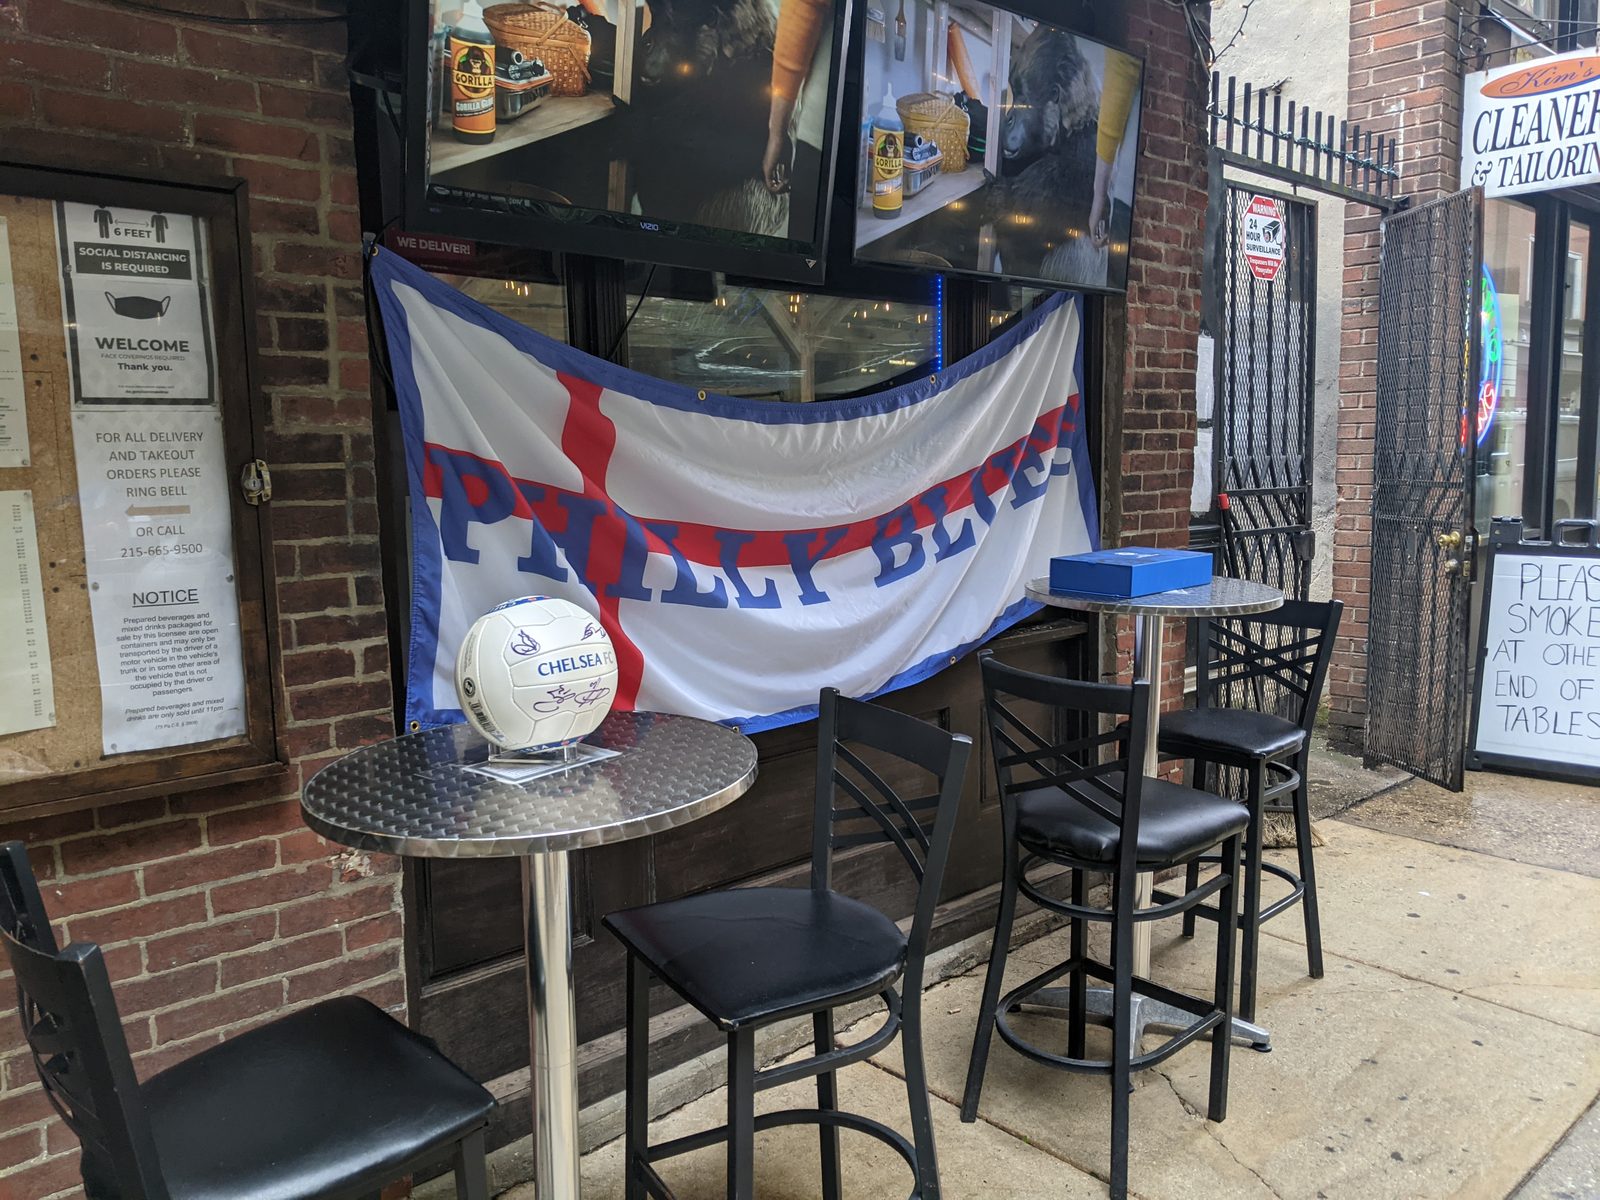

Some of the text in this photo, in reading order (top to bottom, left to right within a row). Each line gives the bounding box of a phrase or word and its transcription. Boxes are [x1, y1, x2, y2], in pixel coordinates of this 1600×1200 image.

[456, 73, 492, 86] GORILLA
[1500, 61, 1594, 94] Kim's
[876, 158, 902, 168] GORILLA
[1472, 161, 1492, 186] &
[640, 222, 658, 231] VIZIO
[1249, 218, 1258, 230] 24
[114, 228, 152, 238] 6 FEET
[1246, 232, 1260, 242] HOUR
[396, 236, 470, 254] WE DELIVER!
[1246, 243, 1280, 256] SURVEILLANCE
[79, 247, 187, 262] SOCIAL DISTANCING
[101, 262, 170, 274] IS REQUIRED
[95, 336, 190, 352] WELCOME
[118, 362, 149, 371] Thank
[96, 432, 204, 443] FOR ALL DELIVERY
[109, 450, 195, 461] AND TAKEOUT
[106, 467, 201, 479] ORDERS PLEASE
[126, 486, 187, 497] RING BELL
[136, 525, 185, 537] OR CALL
[430, 449, 846, 608] PHILLY
[121, 543, 203, 558] 215-665-9500
[132, 589, 198, 604] NOTICE
[123, 616, 156, 624] Prepared
[168, 622, 202, 630] packaged
[1508, 603, 1600, 638] SMOKE
[120, 650, 160, 658] transported
[1492, 640, 1526, 663] AT
[538, 651, 614, 676] CHELSEA FC
[130, 682, 162, 690] occupied
[1494, 670, 1595, 700] END OF
[125, 705, 155, 714] Prepared
[156, 702, 191, 711] beverages
[161, 711, 175, 719] only
[1496, 705, 1600, 740] TABLES
